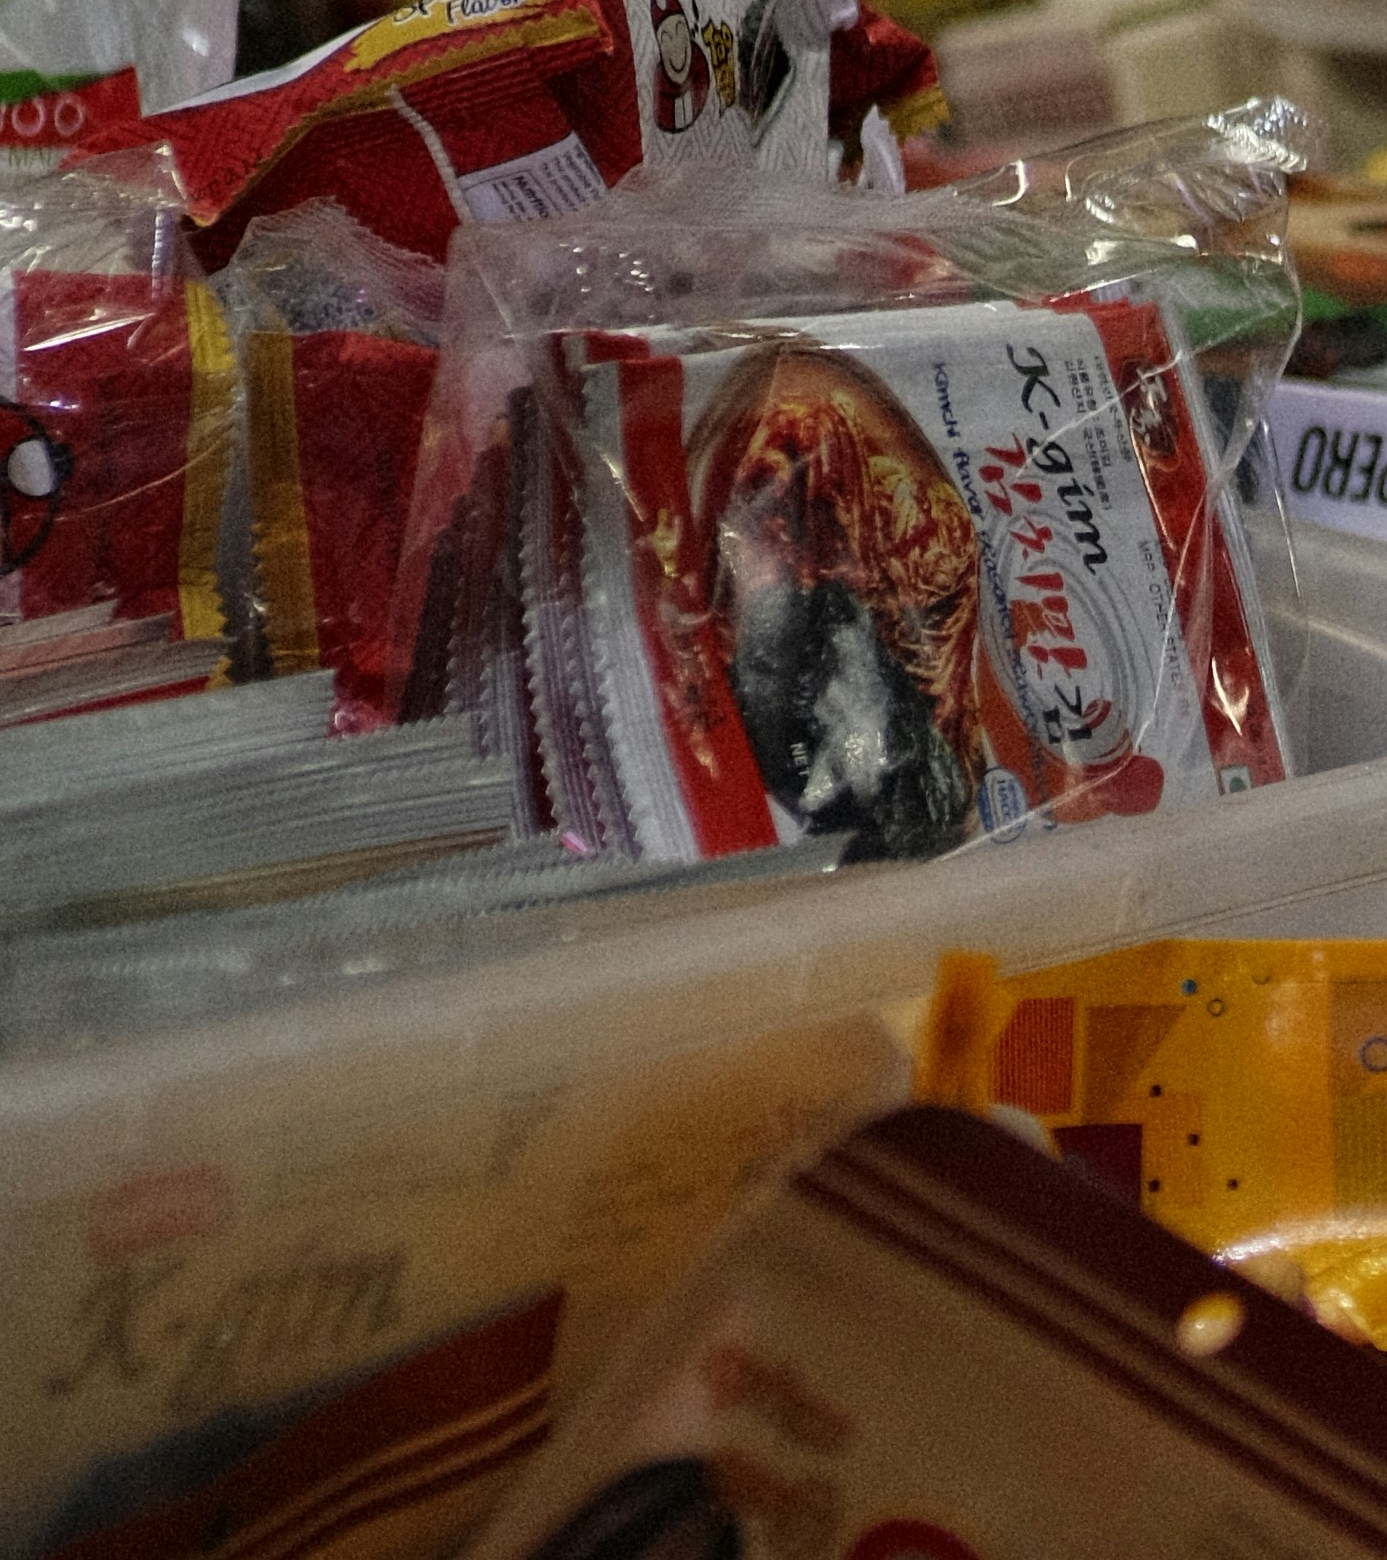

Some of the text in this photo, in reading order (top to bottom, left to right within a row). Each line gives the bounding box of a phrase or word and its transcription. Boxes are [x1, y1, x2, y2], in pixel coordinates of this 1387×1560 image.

[932, 362, 963, 439] Kimchi
[953, 448, 986, 523] flavor
[1007, 343, 1108, 575] K-gim
